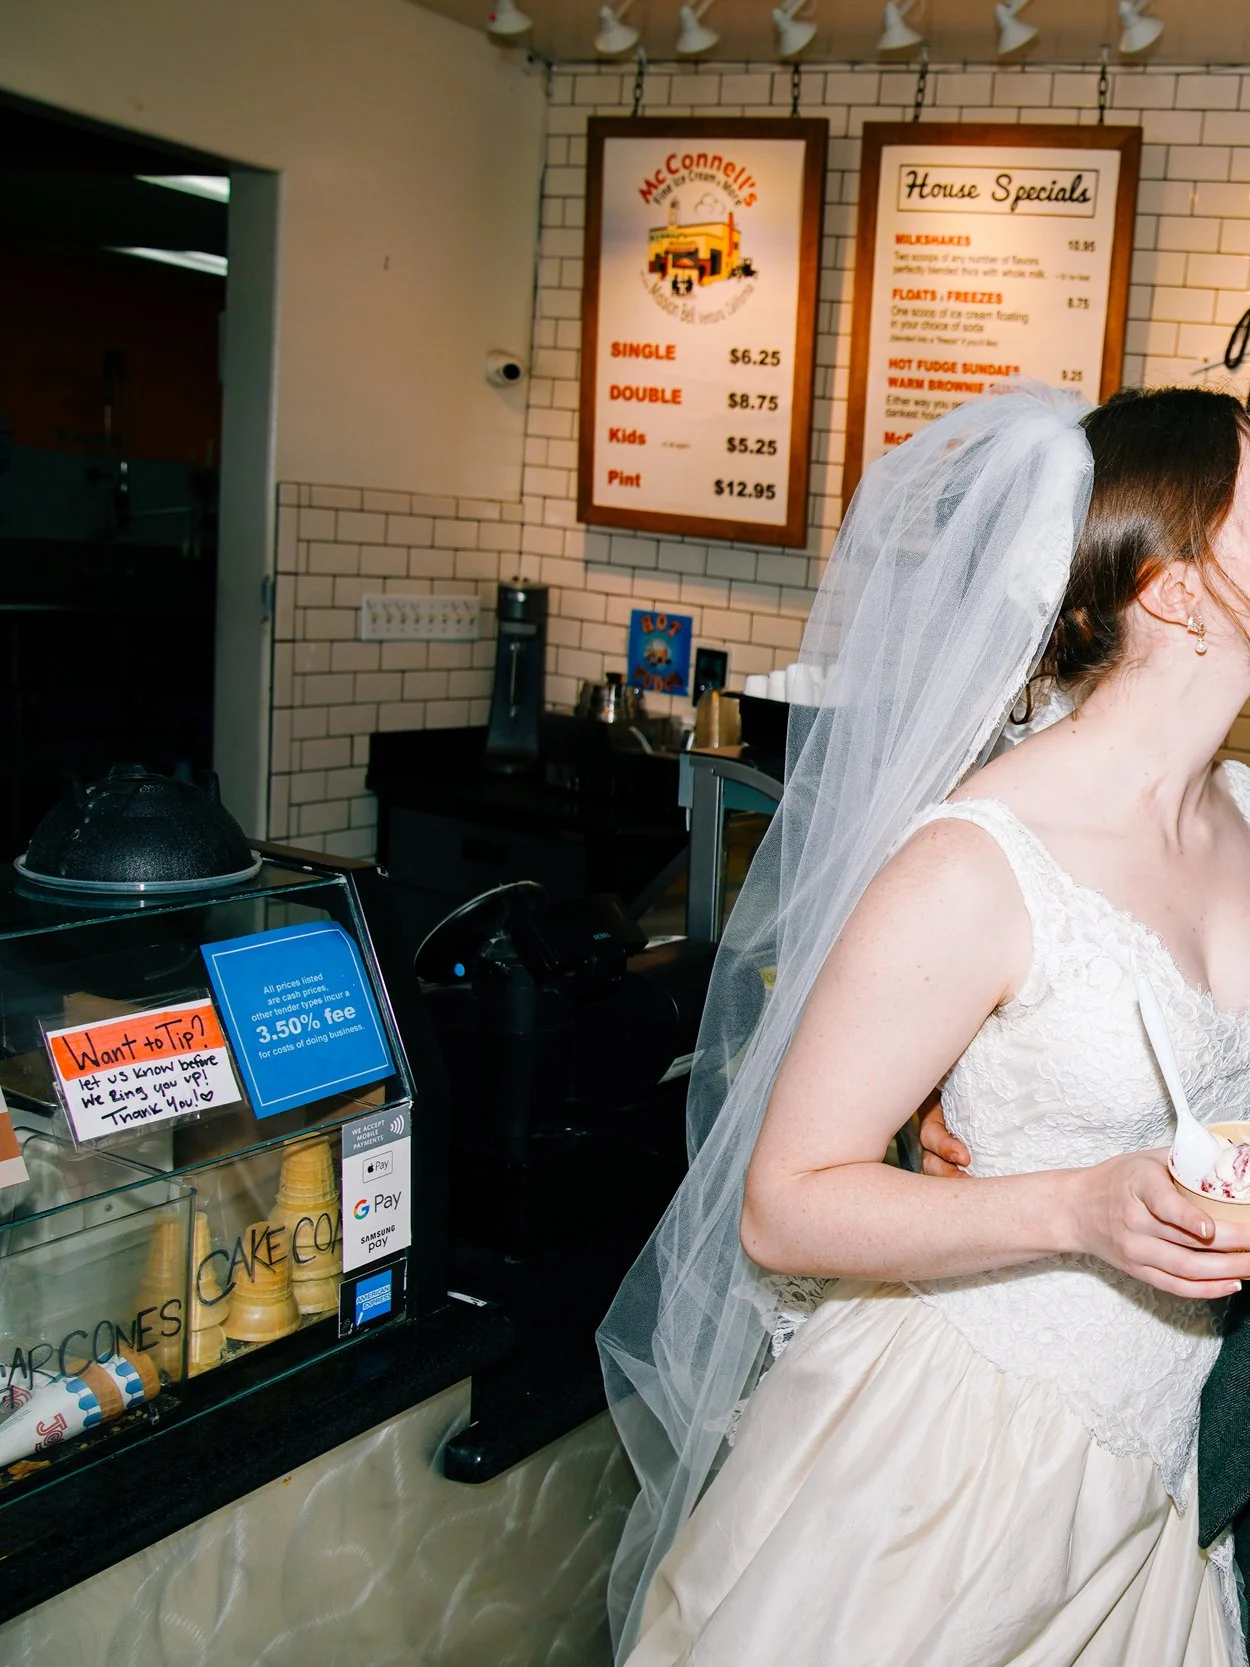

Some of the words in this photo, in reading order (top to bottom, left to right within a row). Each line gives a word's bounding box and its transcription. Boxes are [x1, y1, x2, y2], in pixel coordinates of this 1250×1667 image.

[638, 153, 758, 207] McConnell's
[688, 170, 717, 182] Cream
[905, 170, 980, 200] House
[991, 173, 1091, 214] Specials
[895, 234, 971, 247] MILKSHAKES
[892, 288, 937, 301] FLOATS
[947, 290, 1003, 305] FREEZES
[611, 341, 677, 361] SINGLE
[729, 348, 781, 367] $6.25
[889, 357, 913, 370] HOT
[916, 360, 957, 374] FUDGE
[609, 384, 683, 405] DOUBLE
[887, 376, 924, 390] WARM
[928, 379, 984, 393] BROWNIE
[728, 392, 778, 412] $8.75
[608, 427, 647, 446] Kids
[726, 436, 778, 456] $5.25
[607, 469, 641, 488] Pint
[714, 479, 776, 501] $12.95
[641, 612, 682, 638] HOT
[263, 986, 275, 995] All
[276, 979, 300, 992] prices
[301, 972, 323, 985] listed
[251, 1009, 273, 1022] other
[274, 1003, 300, 1016] tender
[301, 997, 323, 1010] types
[323, 991, 343, 1003] incur
[267, 996, 281, 1006] are
[282, 991, 301, 1002] cash
[256, 1012, 321, 1044] 3.50%
[324, 1006, 356, 1025] fee
[62, 1032, 137, 1071] Want
[144, 1036, 163, 1052] to
[155, 1014, 208, 1051] Tip?
[258, 1049, 271, 1060] for
[272, 1043, 295, 1056] costs
[296, 1038, 305, 1049] of
[305, 1032, 328, 1046] doing
[329, 1023, 366, 1039] business.
[107, 1071, 129, 1084] us
[178, 1053, 218, 1072] before
[153, 1080, 178, 1097] you
[184, 1069, 209, 1088] up!
[101, 1102, 163, 1126] Thank
[351, 1127, 361, 1136] WE
[362, 1120, 385, 1132] ACCEPT
[356, 1129, 379, 1142] MOBILE
[353, 1135, 384, 1150] PAYMENTS
[375, 1160, 389, 1171] Pay
[374, 1191, 402, 1213] Pay
[360, 1224, 396, 1245] SAMSUNG
[368, 1236, 388, 1254] pay
[197, 1225, 289, 1307] CAKE
[355, 1284, 391, 1306] AMERICAN
[58, 1298, 183, 1379] CONES
